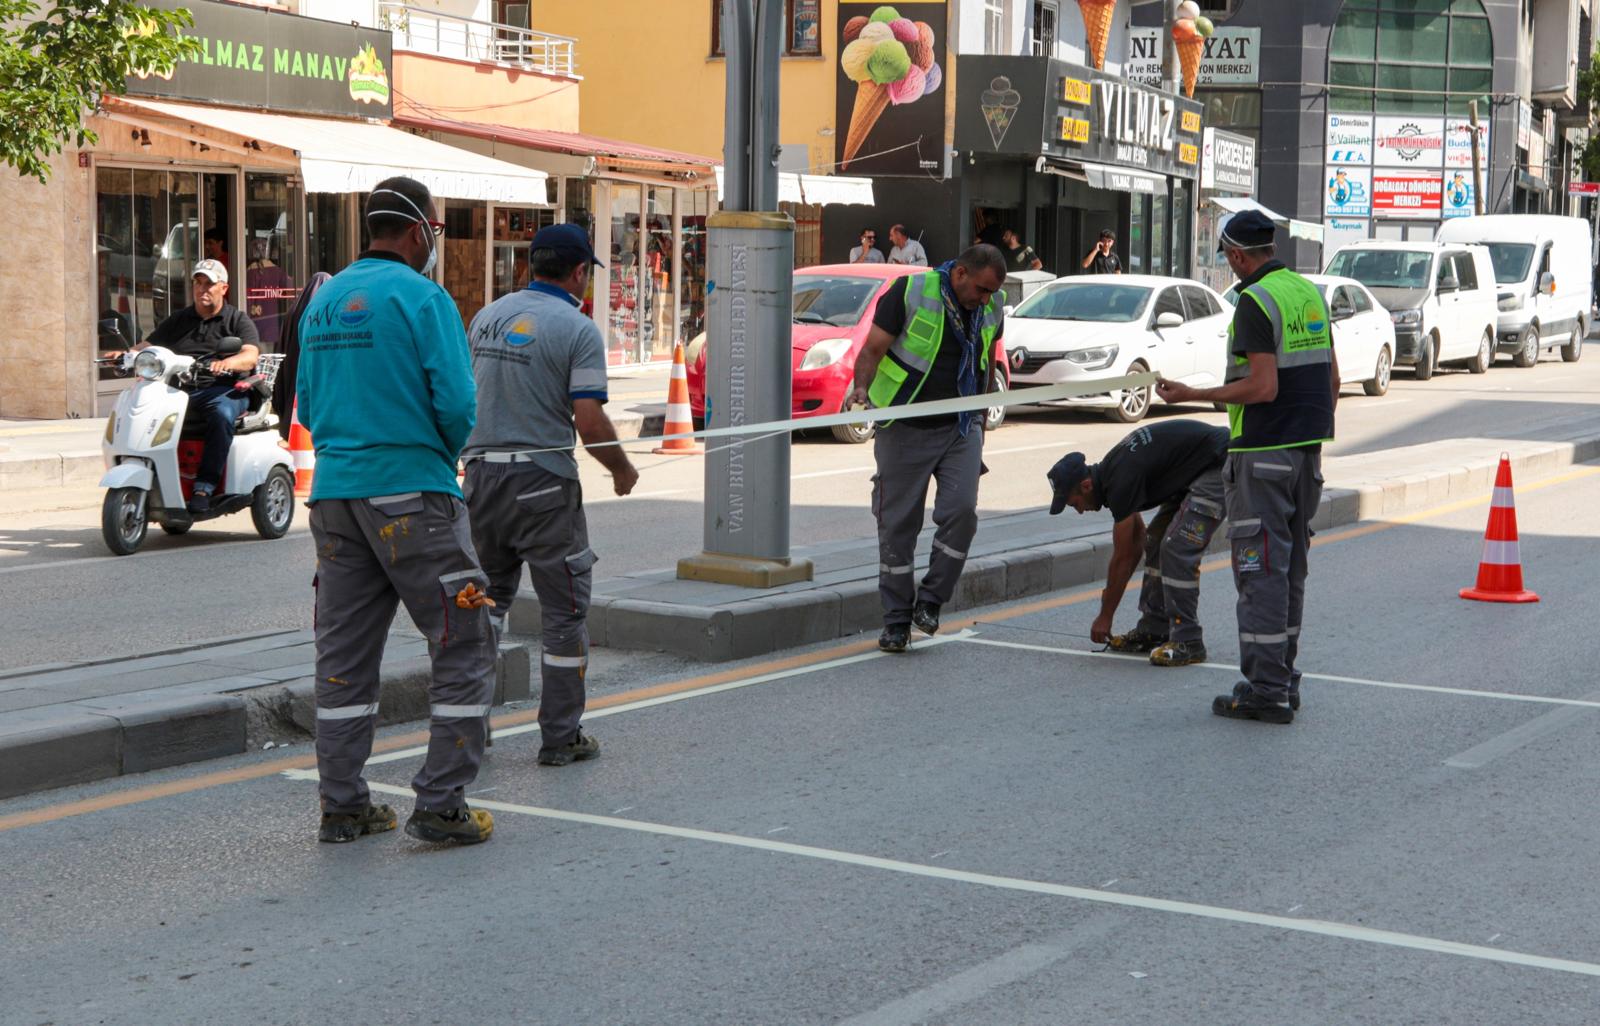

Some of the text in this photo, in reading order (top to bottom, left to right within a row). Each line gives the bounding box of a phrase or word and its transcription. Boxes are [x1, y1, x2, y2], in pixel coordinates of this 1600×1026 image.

[274, 48, 347, 82] MANAV
[1216, 62, 1252, 74] MERKEZİ
[1101, 80, 1175, 151] YILMAZ
[1215, 138, 1253, 174] KARDEŞLER
[1337, 134, 1370, 146] Vaillant
[726, 365, 745, 488] BÜYÜŞEHİR
[729, 495, 745, 534] VAN
